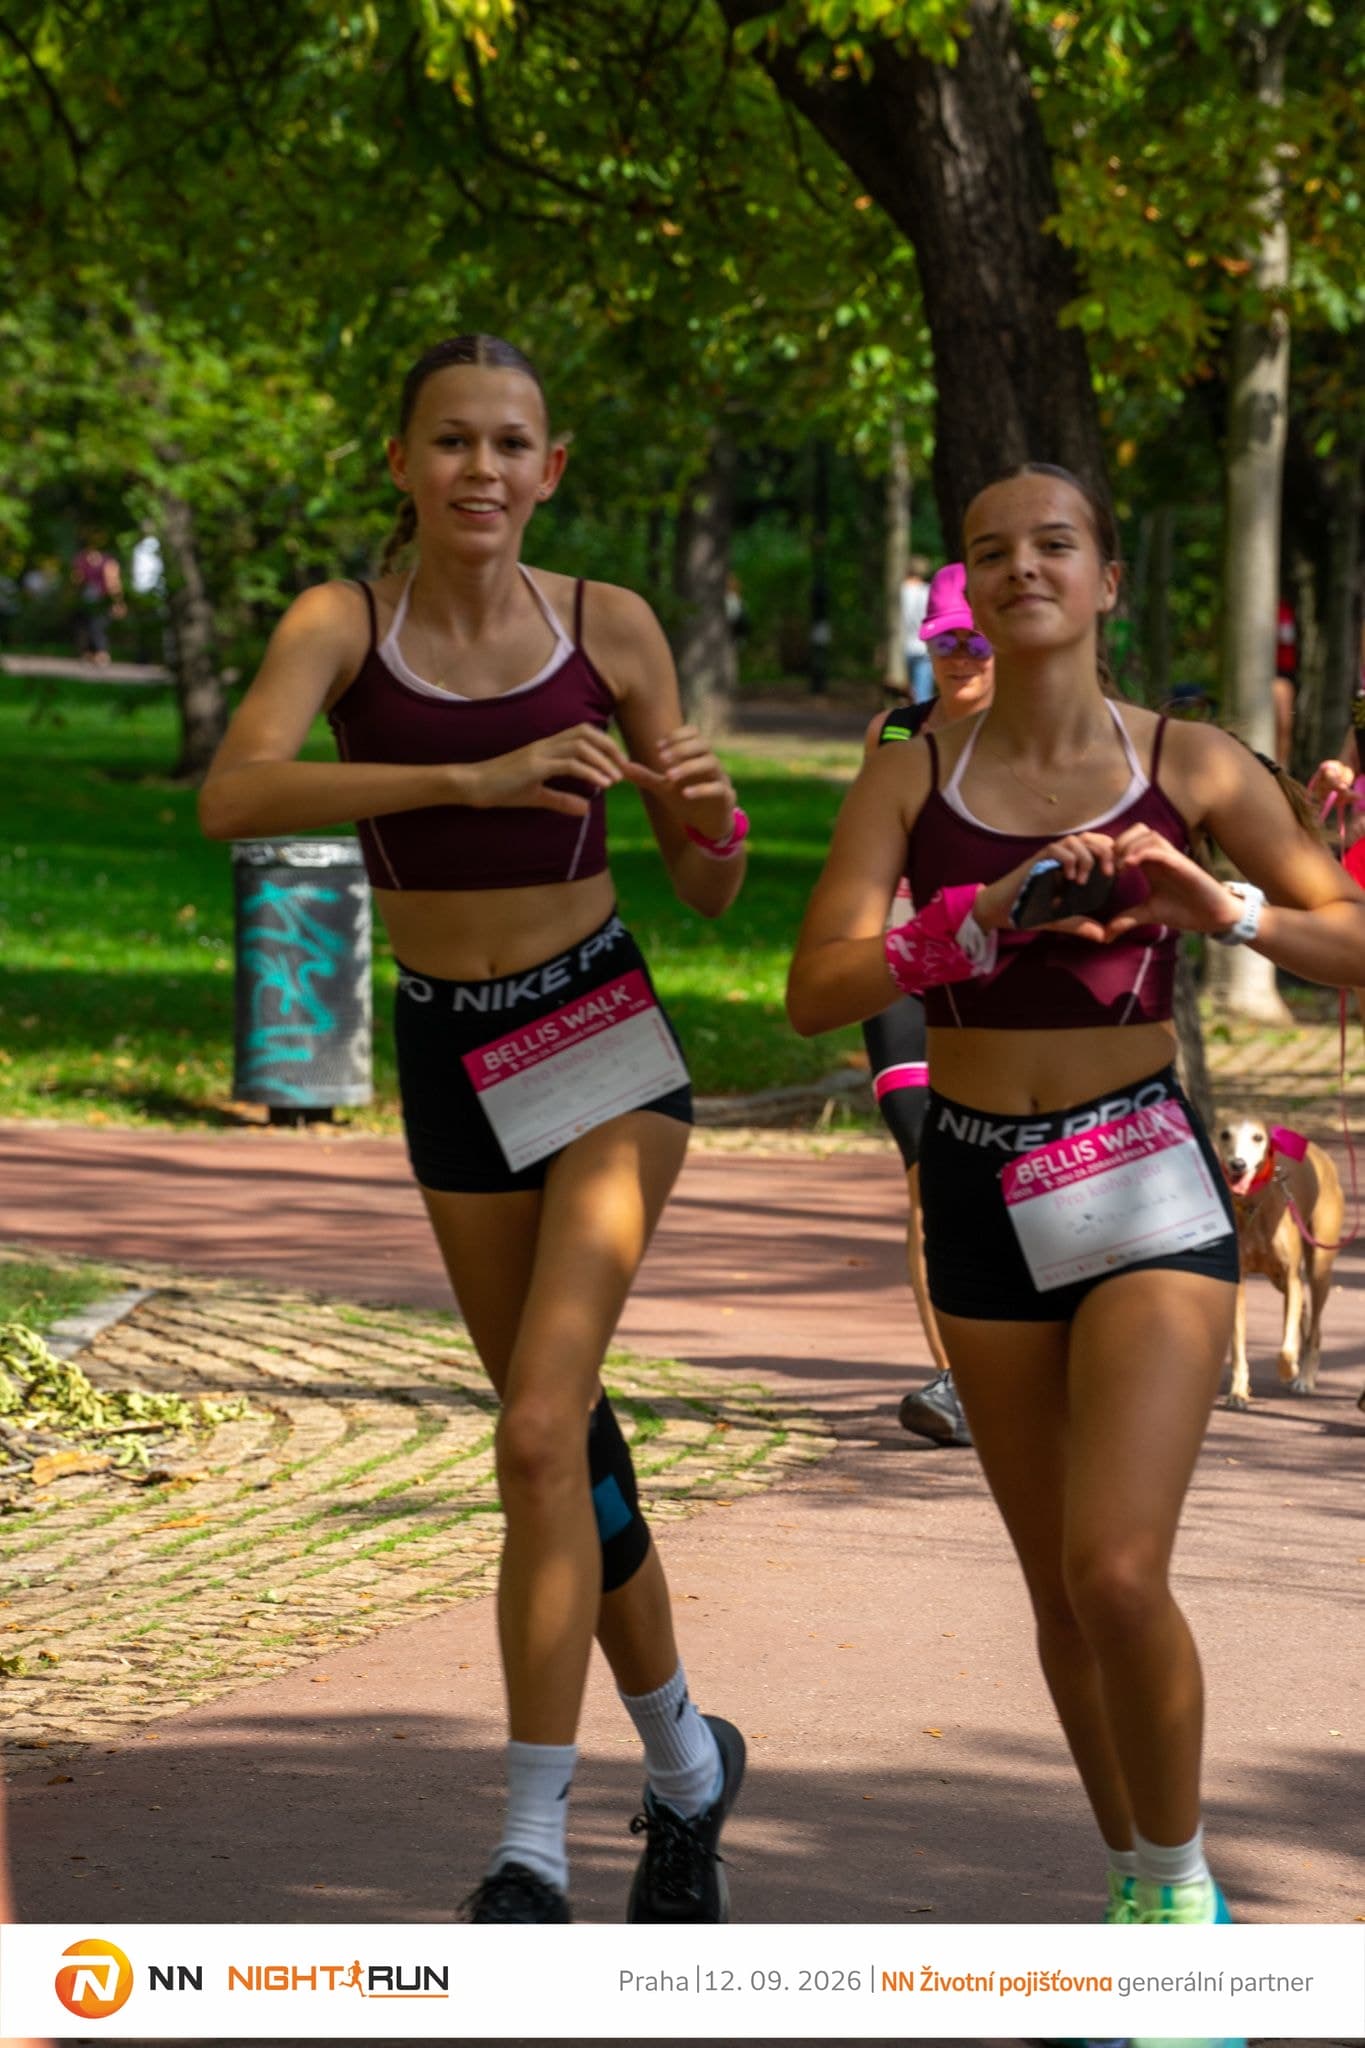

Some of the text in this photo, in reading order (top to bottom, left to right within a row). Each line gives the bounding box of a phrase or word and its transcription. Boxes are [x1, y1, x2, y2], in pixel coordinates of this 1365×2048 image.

[452, 956, 573, 1013] NIKE
[580, 917, 625, 972] PR
[481, 1022, 561, 1073] BELLIS
[560, 985, 632, 1031] WALK
[937, 1106, 1052, 1152] NIKE
[1015, 1113, 1165, 1186] BELLIS WALK
